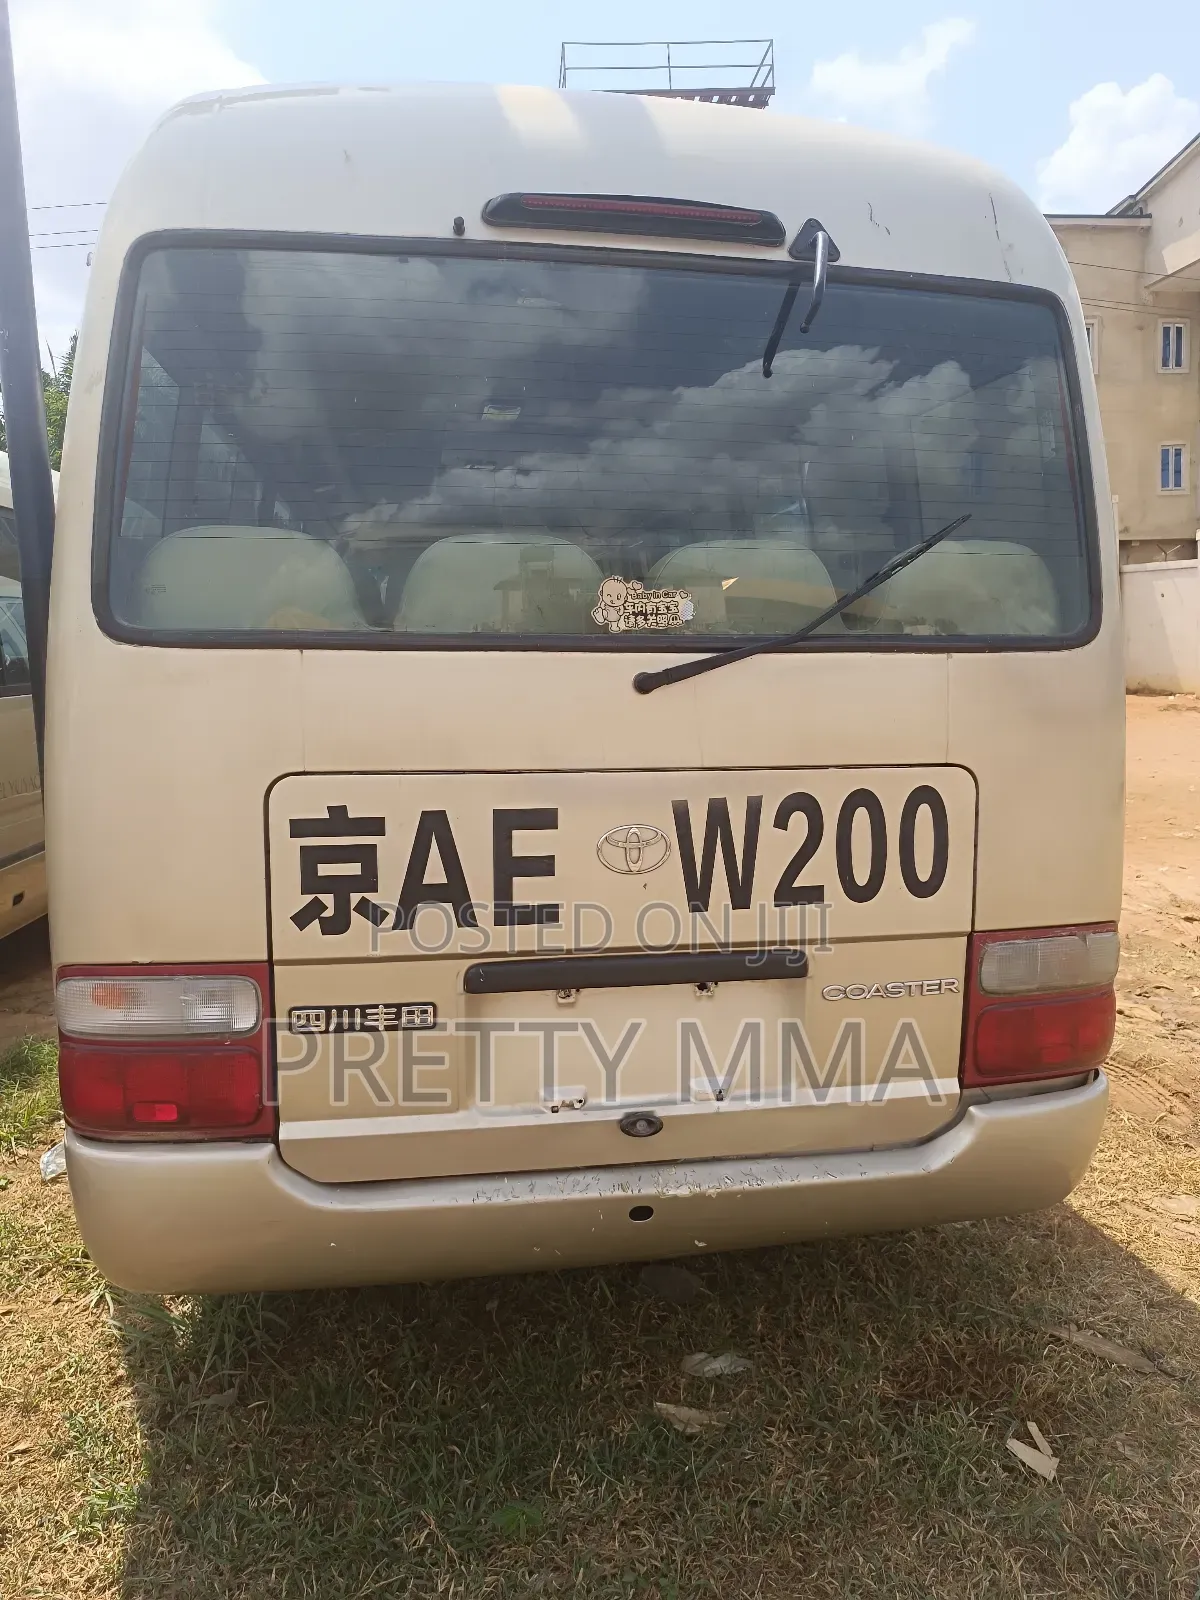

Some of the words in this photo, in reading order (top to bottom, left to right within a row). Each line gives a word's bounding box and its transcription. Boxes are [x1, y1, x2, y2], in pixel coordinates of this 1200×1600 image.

[631, 591, 652, 600] Baby
[662, 590, 677, 598] Car
[624, 600, 679, 613] 车内有宝宝
[624, 613, 668, 628] 请多关照
[671, 785, 949, 913] W200
[822, 978, 959, 1001] COASTER
[291, 1004, 435, 1031] 四川丰田
